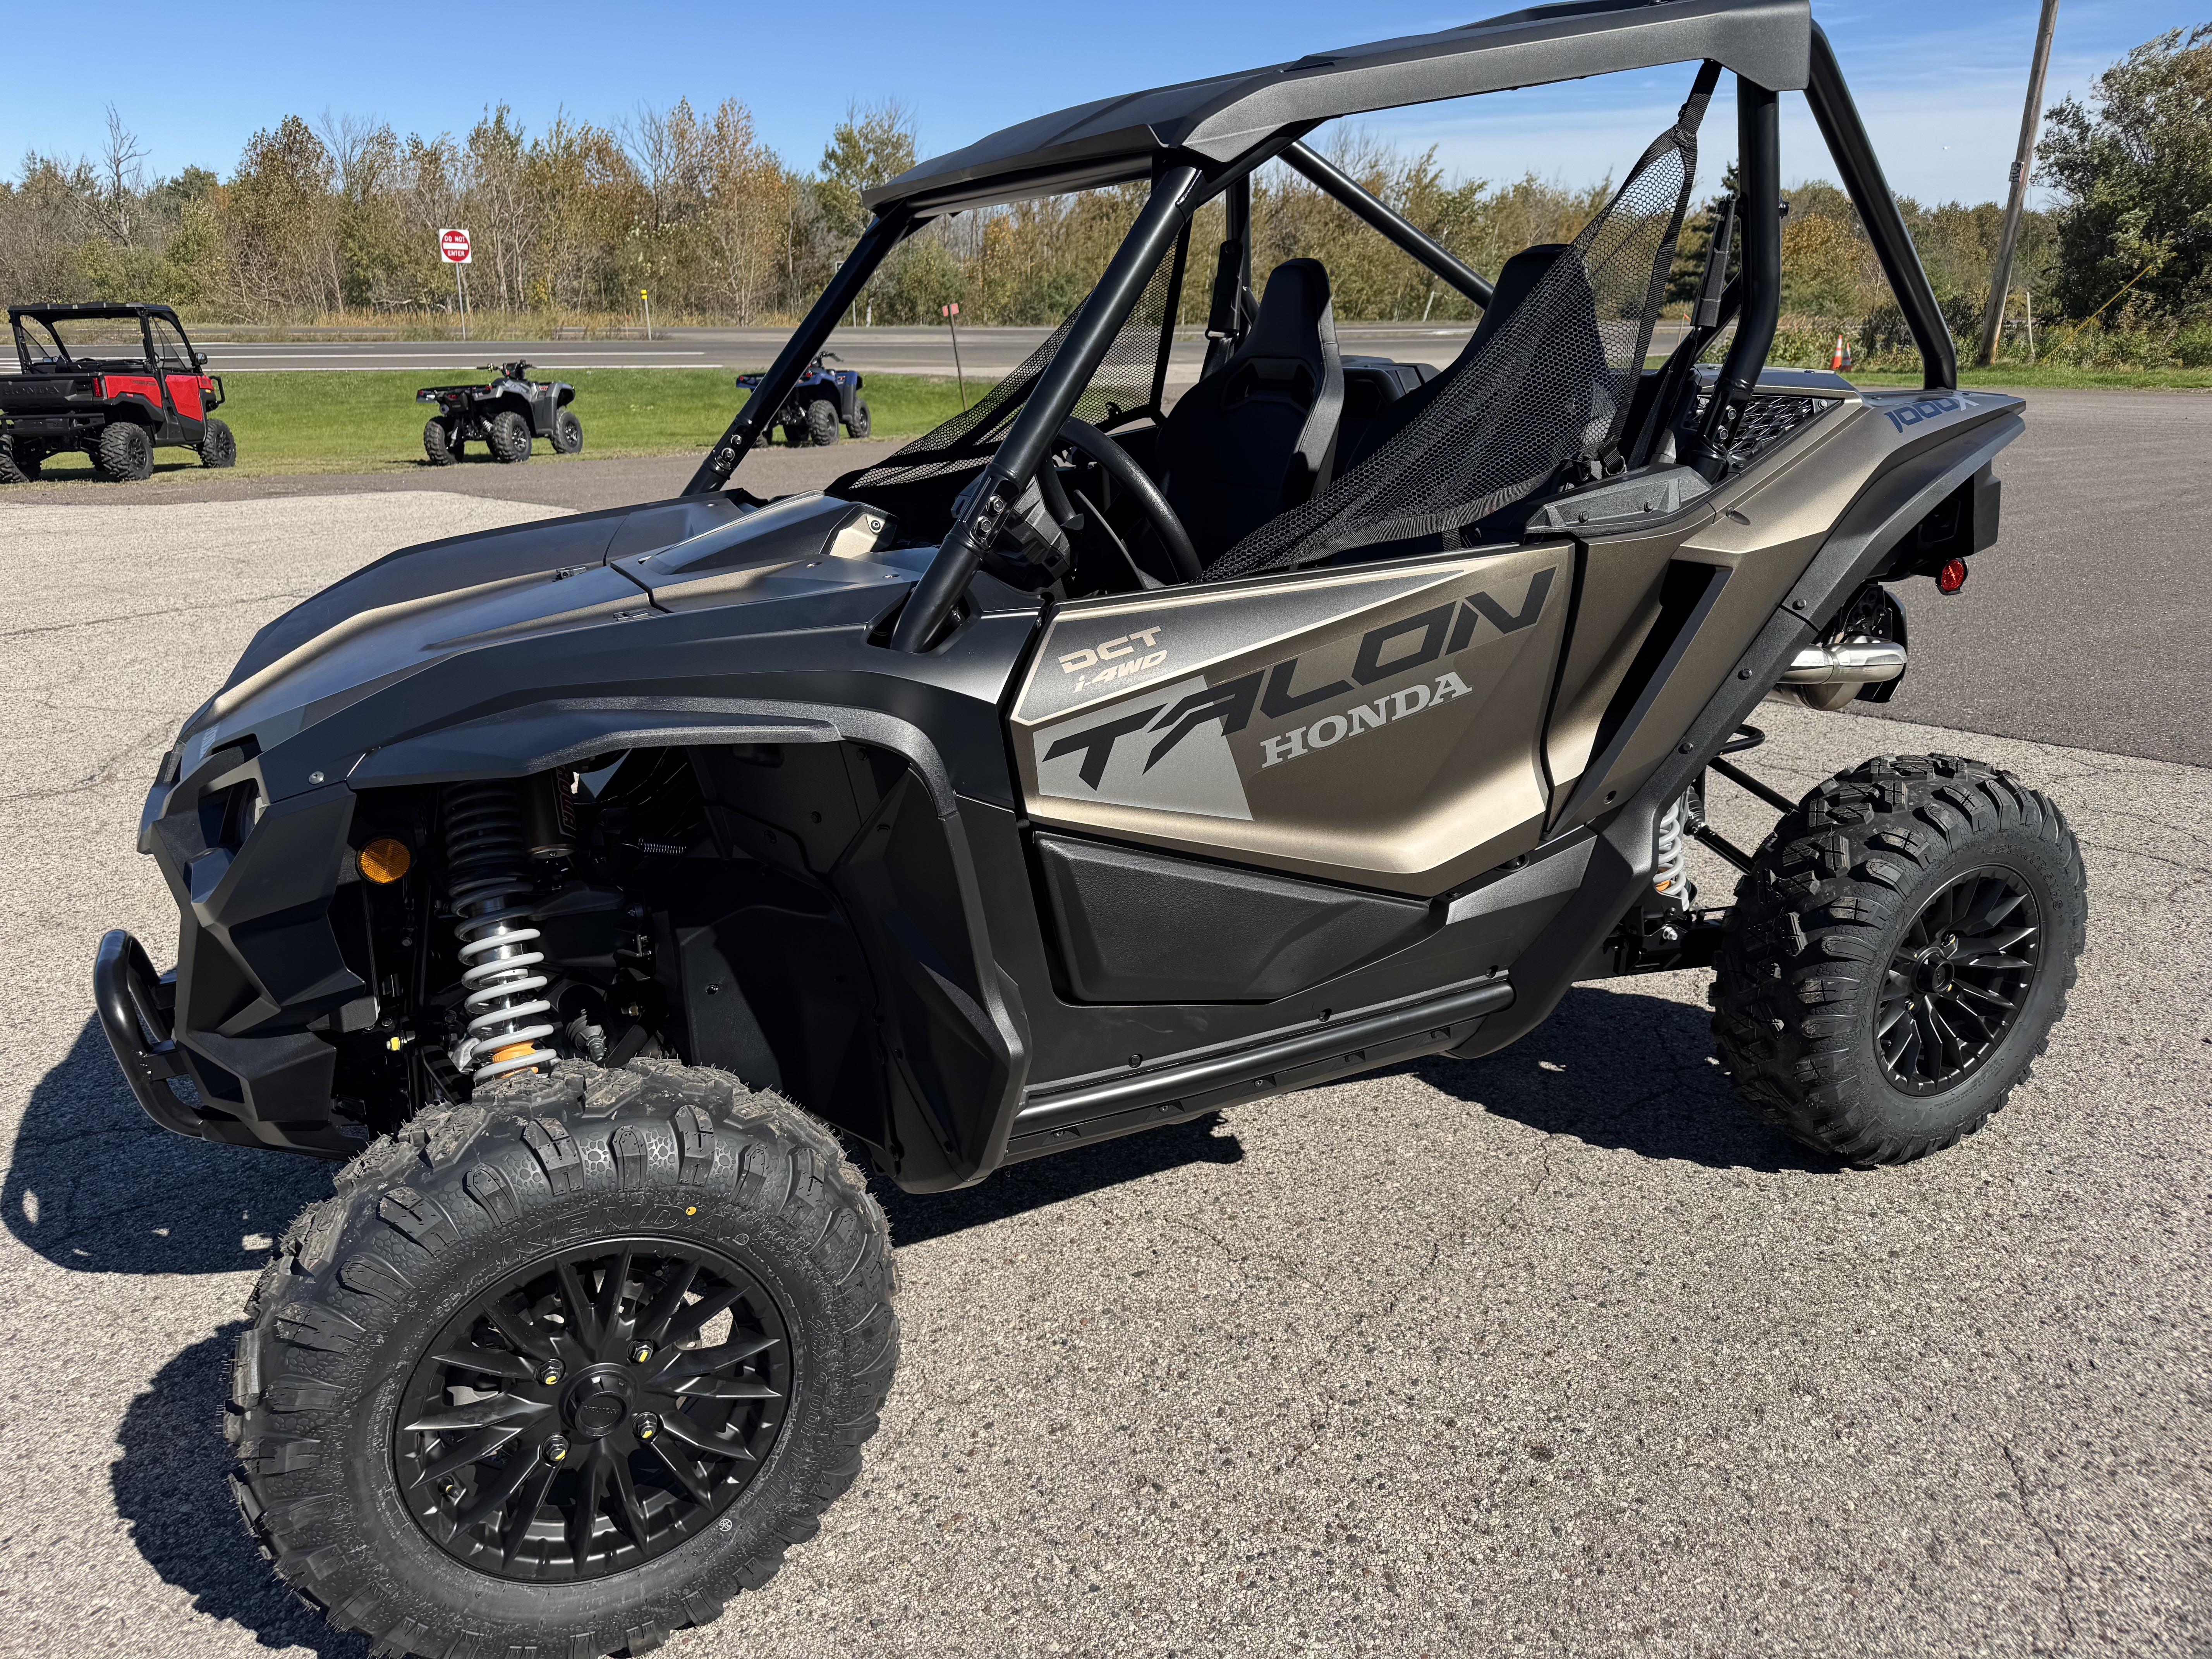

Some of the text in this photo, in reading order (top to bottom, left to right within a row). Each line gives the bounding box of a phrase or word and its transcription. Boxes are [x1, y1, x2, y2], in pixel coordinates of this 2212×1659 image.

[4, 385, 60, 396] HONDA
[1884, 395, 1979, 433] 1000X
[1042, 566, 1557, 792] TALON
[1058, 626, 1161, 674] DCT
[1260, 670, 1473, 769] HONDA
[556, 764, 577, 831] HOWA
[500, 1203, 725, 1267] KENDA
